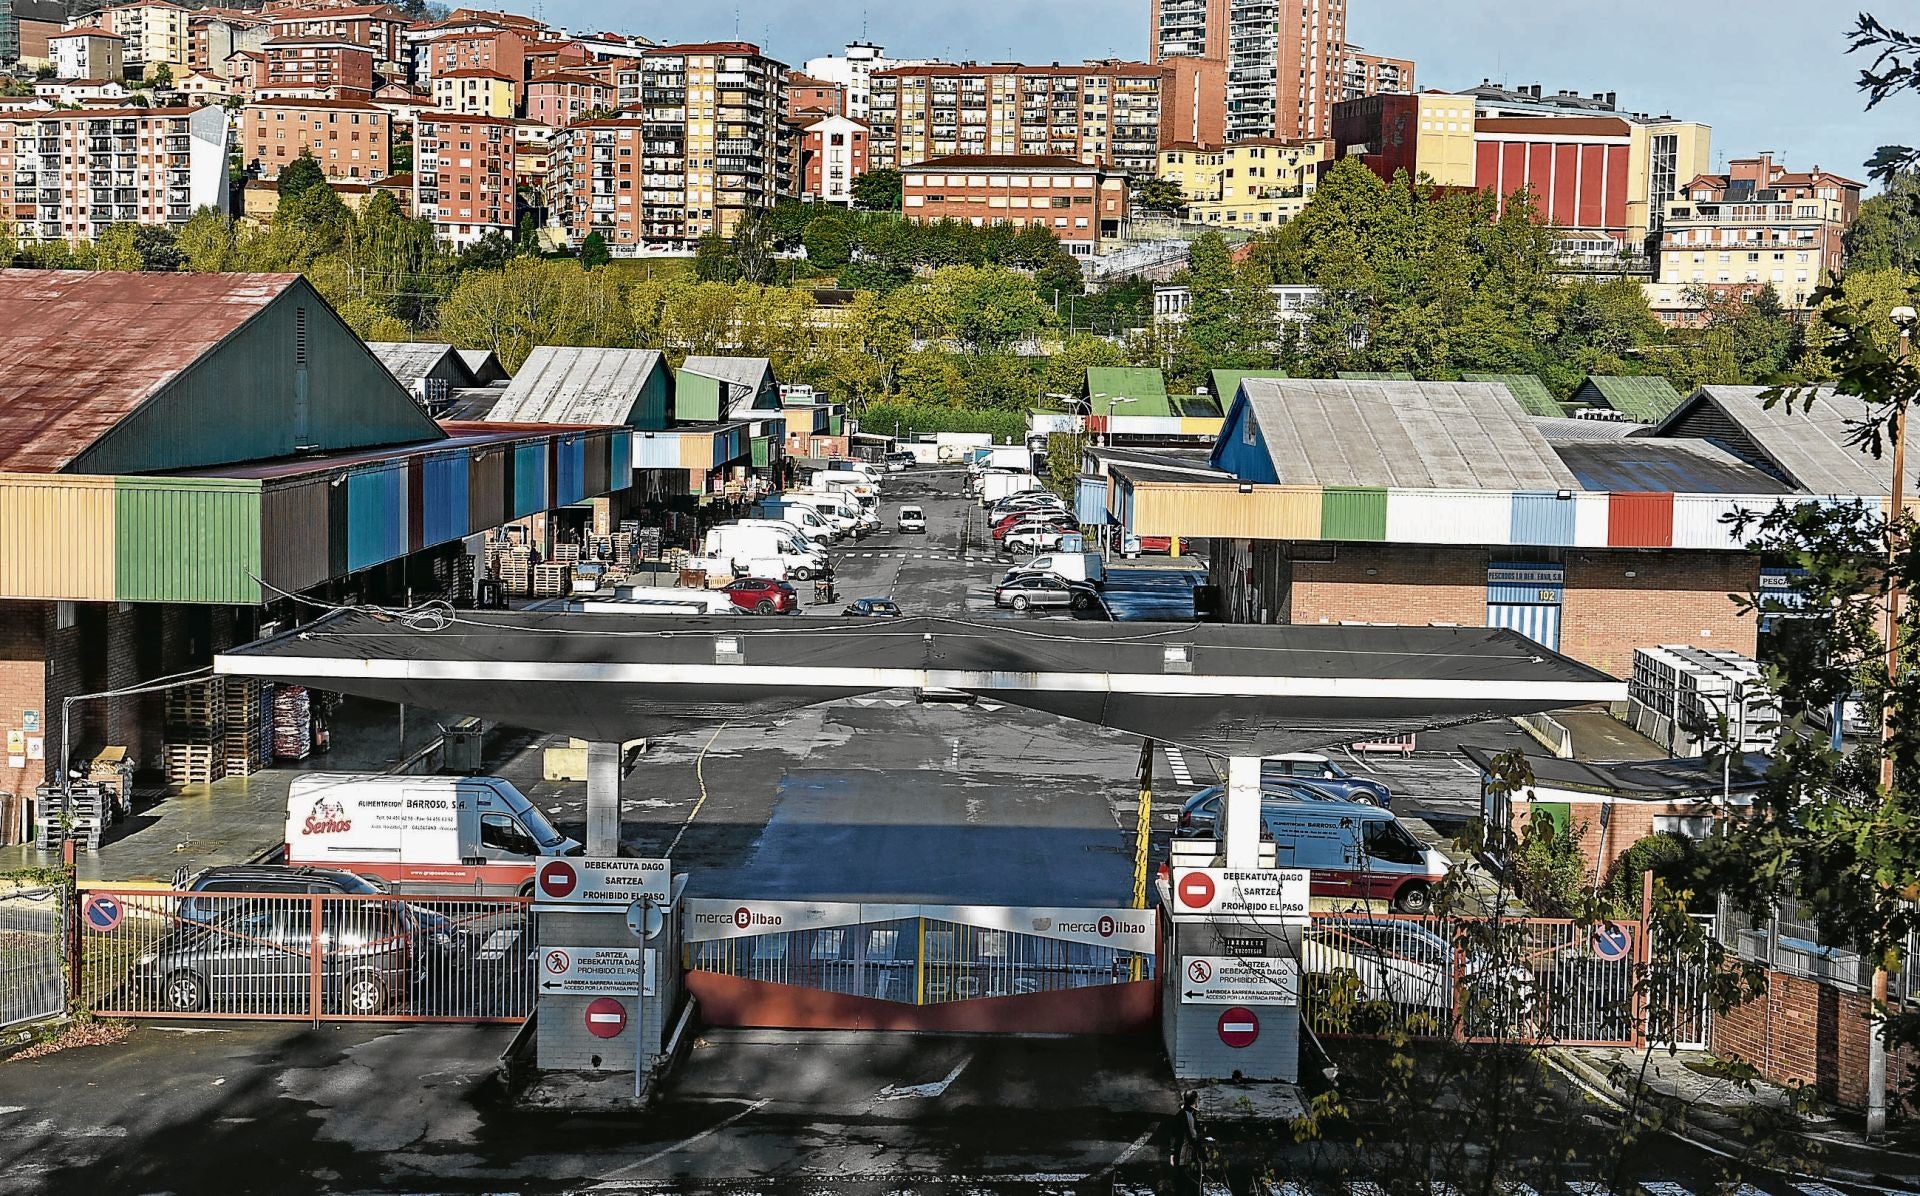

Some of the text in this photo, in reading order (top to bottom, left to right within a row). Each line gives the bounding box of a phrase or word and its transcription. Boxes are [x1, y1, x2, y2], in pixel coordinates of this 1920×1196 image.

[1539, 590, 1555, 601] 102
[358, 799, 468, 810] ALIMENTACION BARROSO, S.A.
[585, 861, 665, 871] DEBEKATUTA DAGO
[605, 876, 643, 886] SARTZEA
[1223, 872, 1277, 881] DEBEKATUTA
[1280, 873, 1303, 882] DAGO
[583, 891, 665, 901] PROHIBIDO EL PASO
[1244, 887, 1281, 896] SARTZEA
[1221, 902, 1267, 911] PROHIBIDO
[1269, 903, 1280, 911] EL
[595, 951, 628, 959] SARTZEA
[577, 958, 624, 966] DEBEKATUTA
[577, 967, 616, 975] PROHIBIDO
[617, 967, 626, 975] EL
[1220, 967, 1288, 976] DEBEKATUTA DAGO
[1220, 976, 1258, 984] PROHIBIDO
